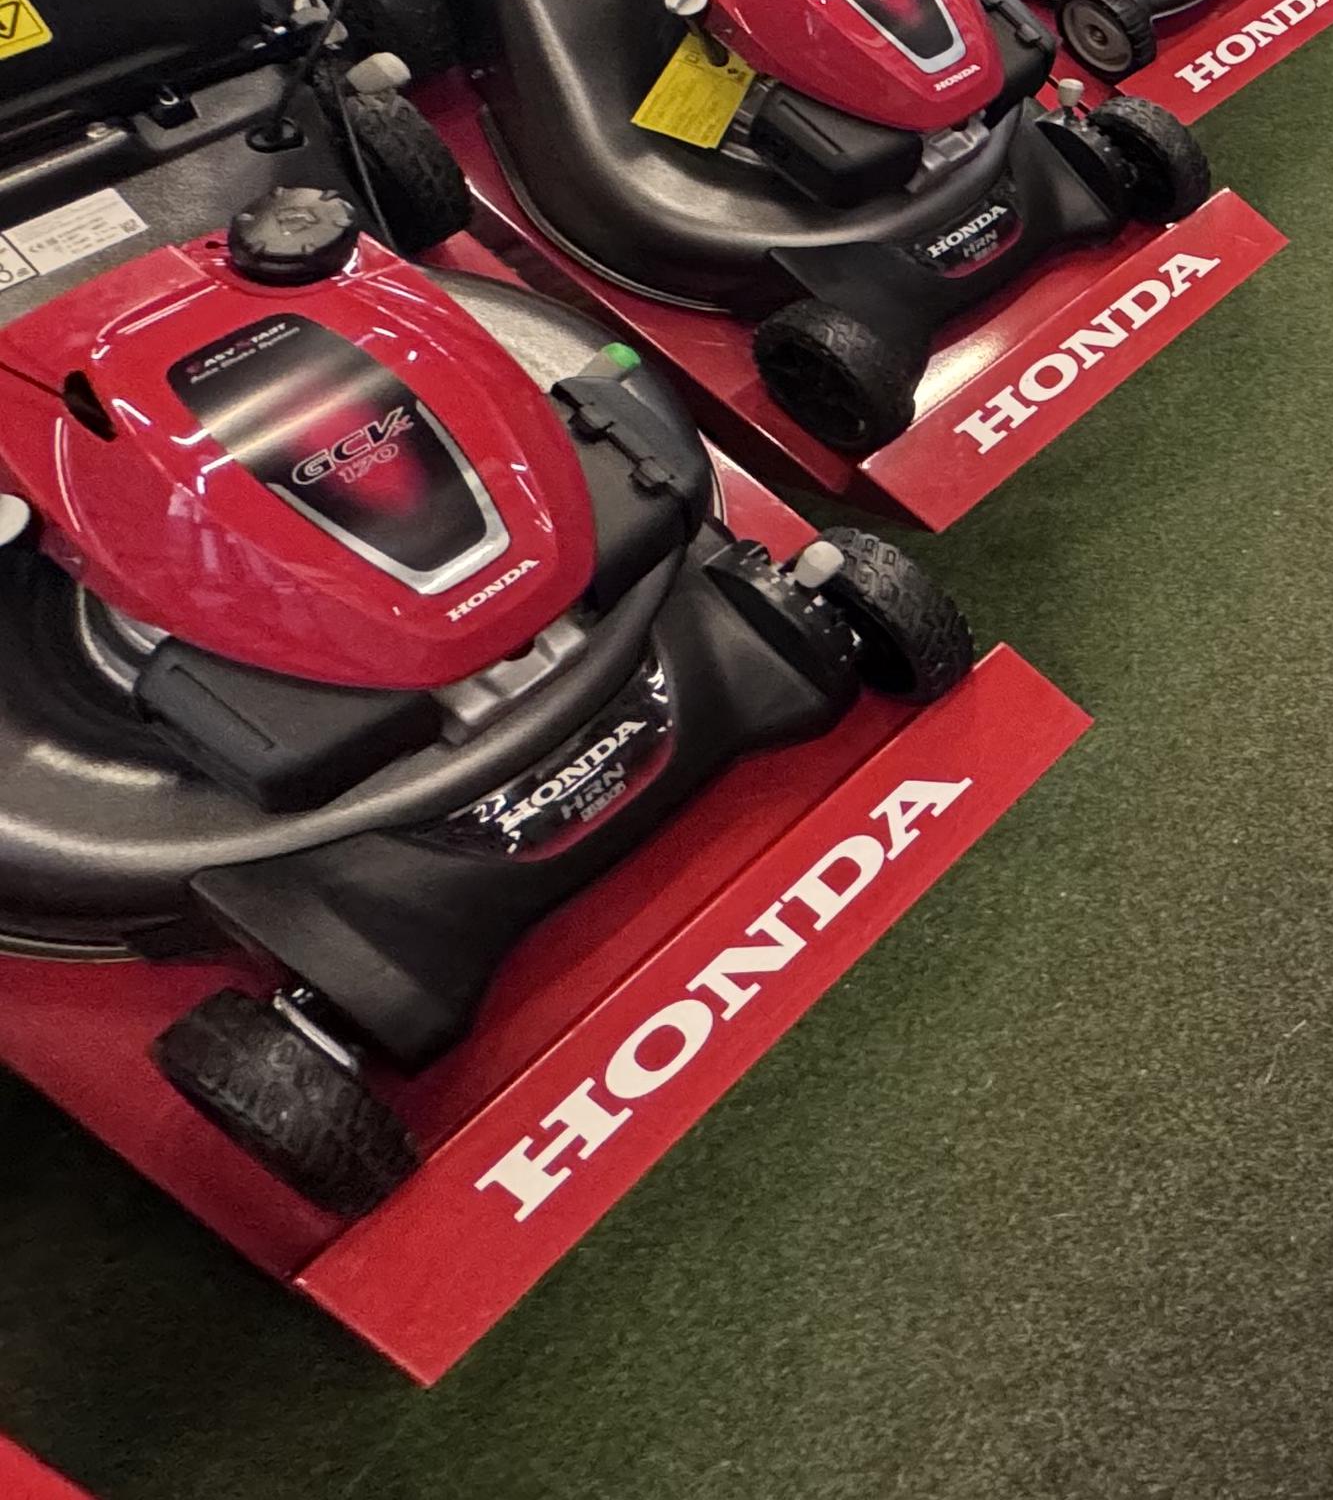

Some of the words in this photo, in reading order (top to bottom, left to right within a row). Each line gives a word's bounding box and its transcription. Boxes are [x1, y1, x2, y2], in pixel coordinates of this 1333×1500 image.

[932, 64, 981, 92] HONDA
[926, 205, 1008, 259] HONDA
[953, 248, 1222, 455] HONDA
[337, 443, 399, 485] 170
[444, 558, 541, 623] HONDA
[495, 720, 648, 834] HONDA
[560, 761, 627, 821] HRN
[474, 776, 974, 1223] HONDA
